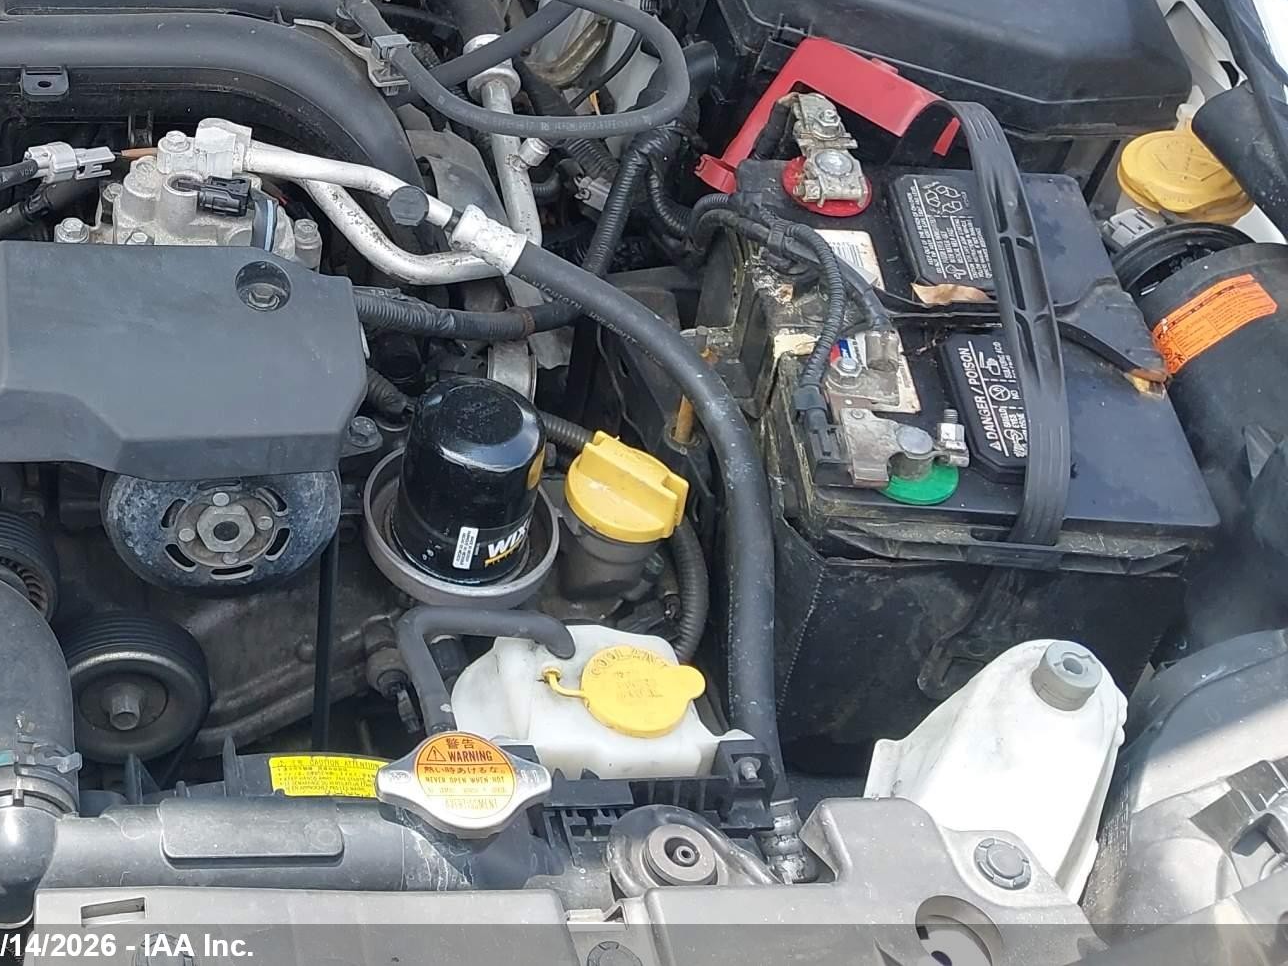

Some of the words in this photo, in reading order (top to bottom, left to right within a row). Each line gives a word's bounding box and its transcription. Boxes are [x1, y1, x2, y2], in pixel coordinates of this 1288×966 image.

[958, 347, 980, 386] POISON
[974, 395, 999, 440] DANGER
[447, 749, 494, 763] WARNING
